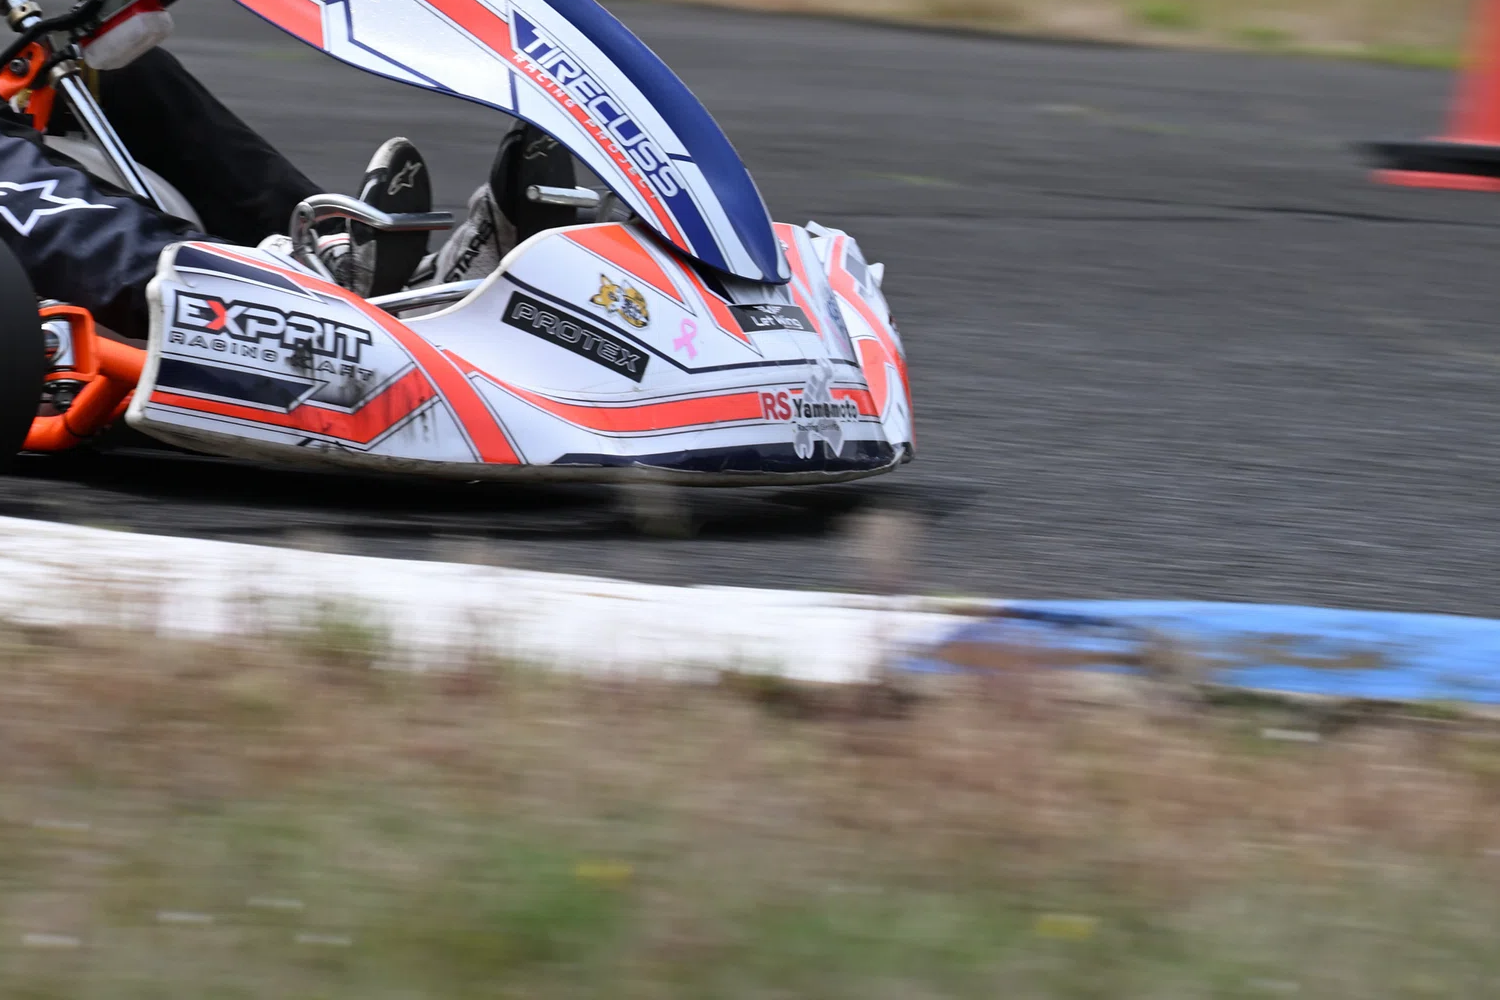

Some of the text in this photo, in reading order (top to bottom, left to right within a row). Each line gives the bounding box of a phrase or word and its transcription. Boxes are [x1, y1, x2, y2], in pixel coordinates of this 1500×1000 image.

[512, 53, 662, 201] RACING PROJECT
[524, 28, 687, 198] TIRECUSS
[168, 330, 279, 363] RACING
[174, 290, 373, 364] EXPRIT
[511, 302, 641, 373] PROTEX
[750, 315, 774, 327] Let
[761, 391, 792, 421] RS
